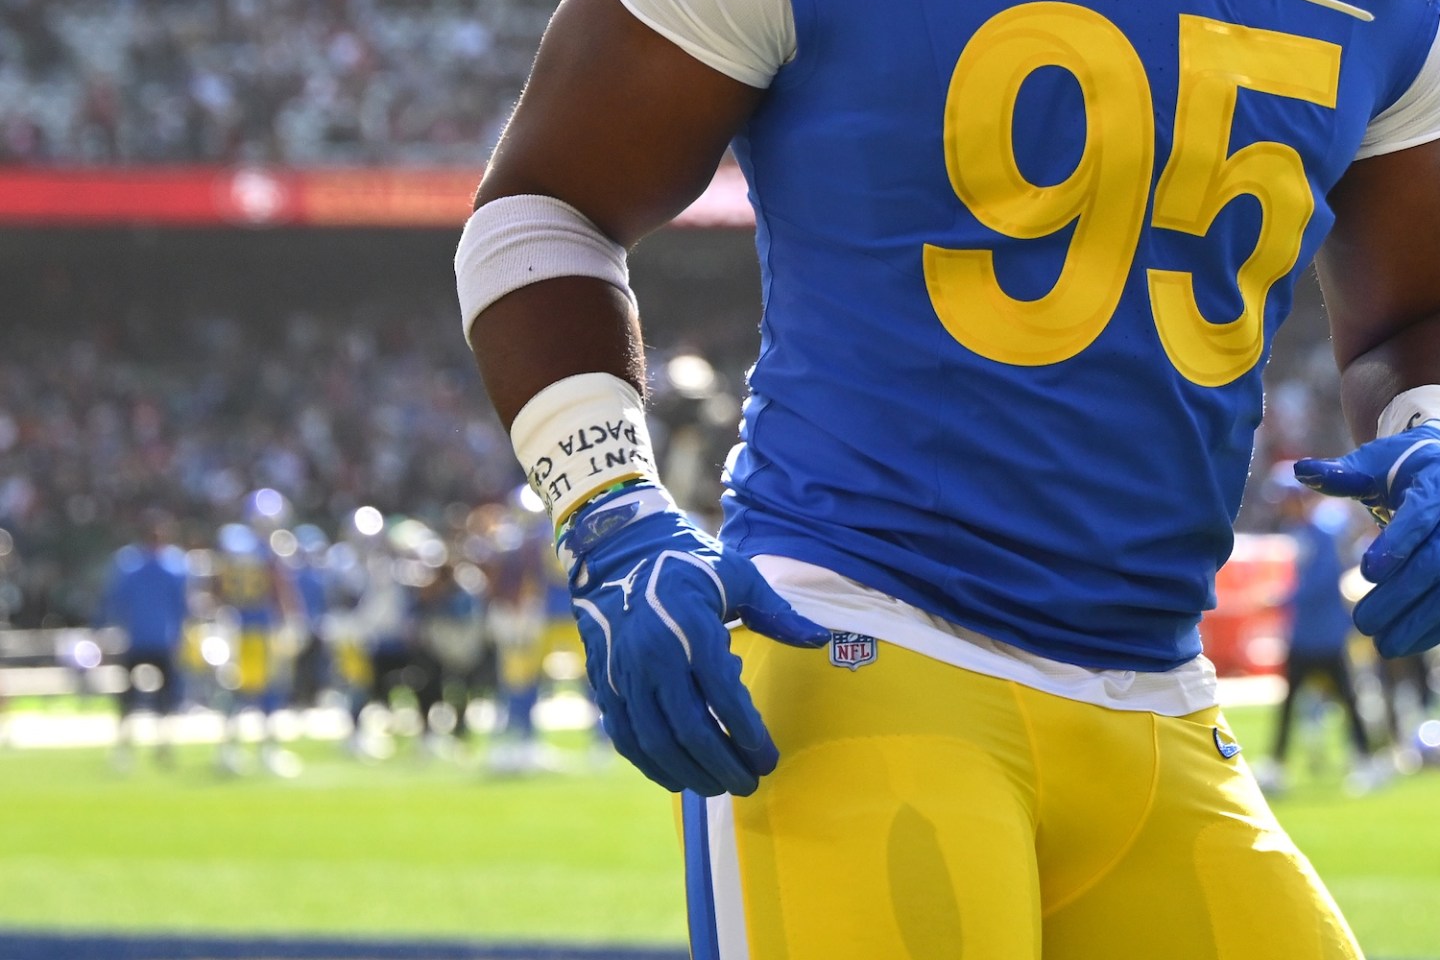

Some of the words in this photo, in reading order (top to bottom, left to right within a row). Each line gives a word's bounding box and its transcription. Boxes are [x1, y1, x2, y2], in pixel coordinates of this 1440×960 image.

[923, 1, 1342, 387] 95
[558, 420, 639, 456] PACTA
[837, 643, 870, 661] NFL
